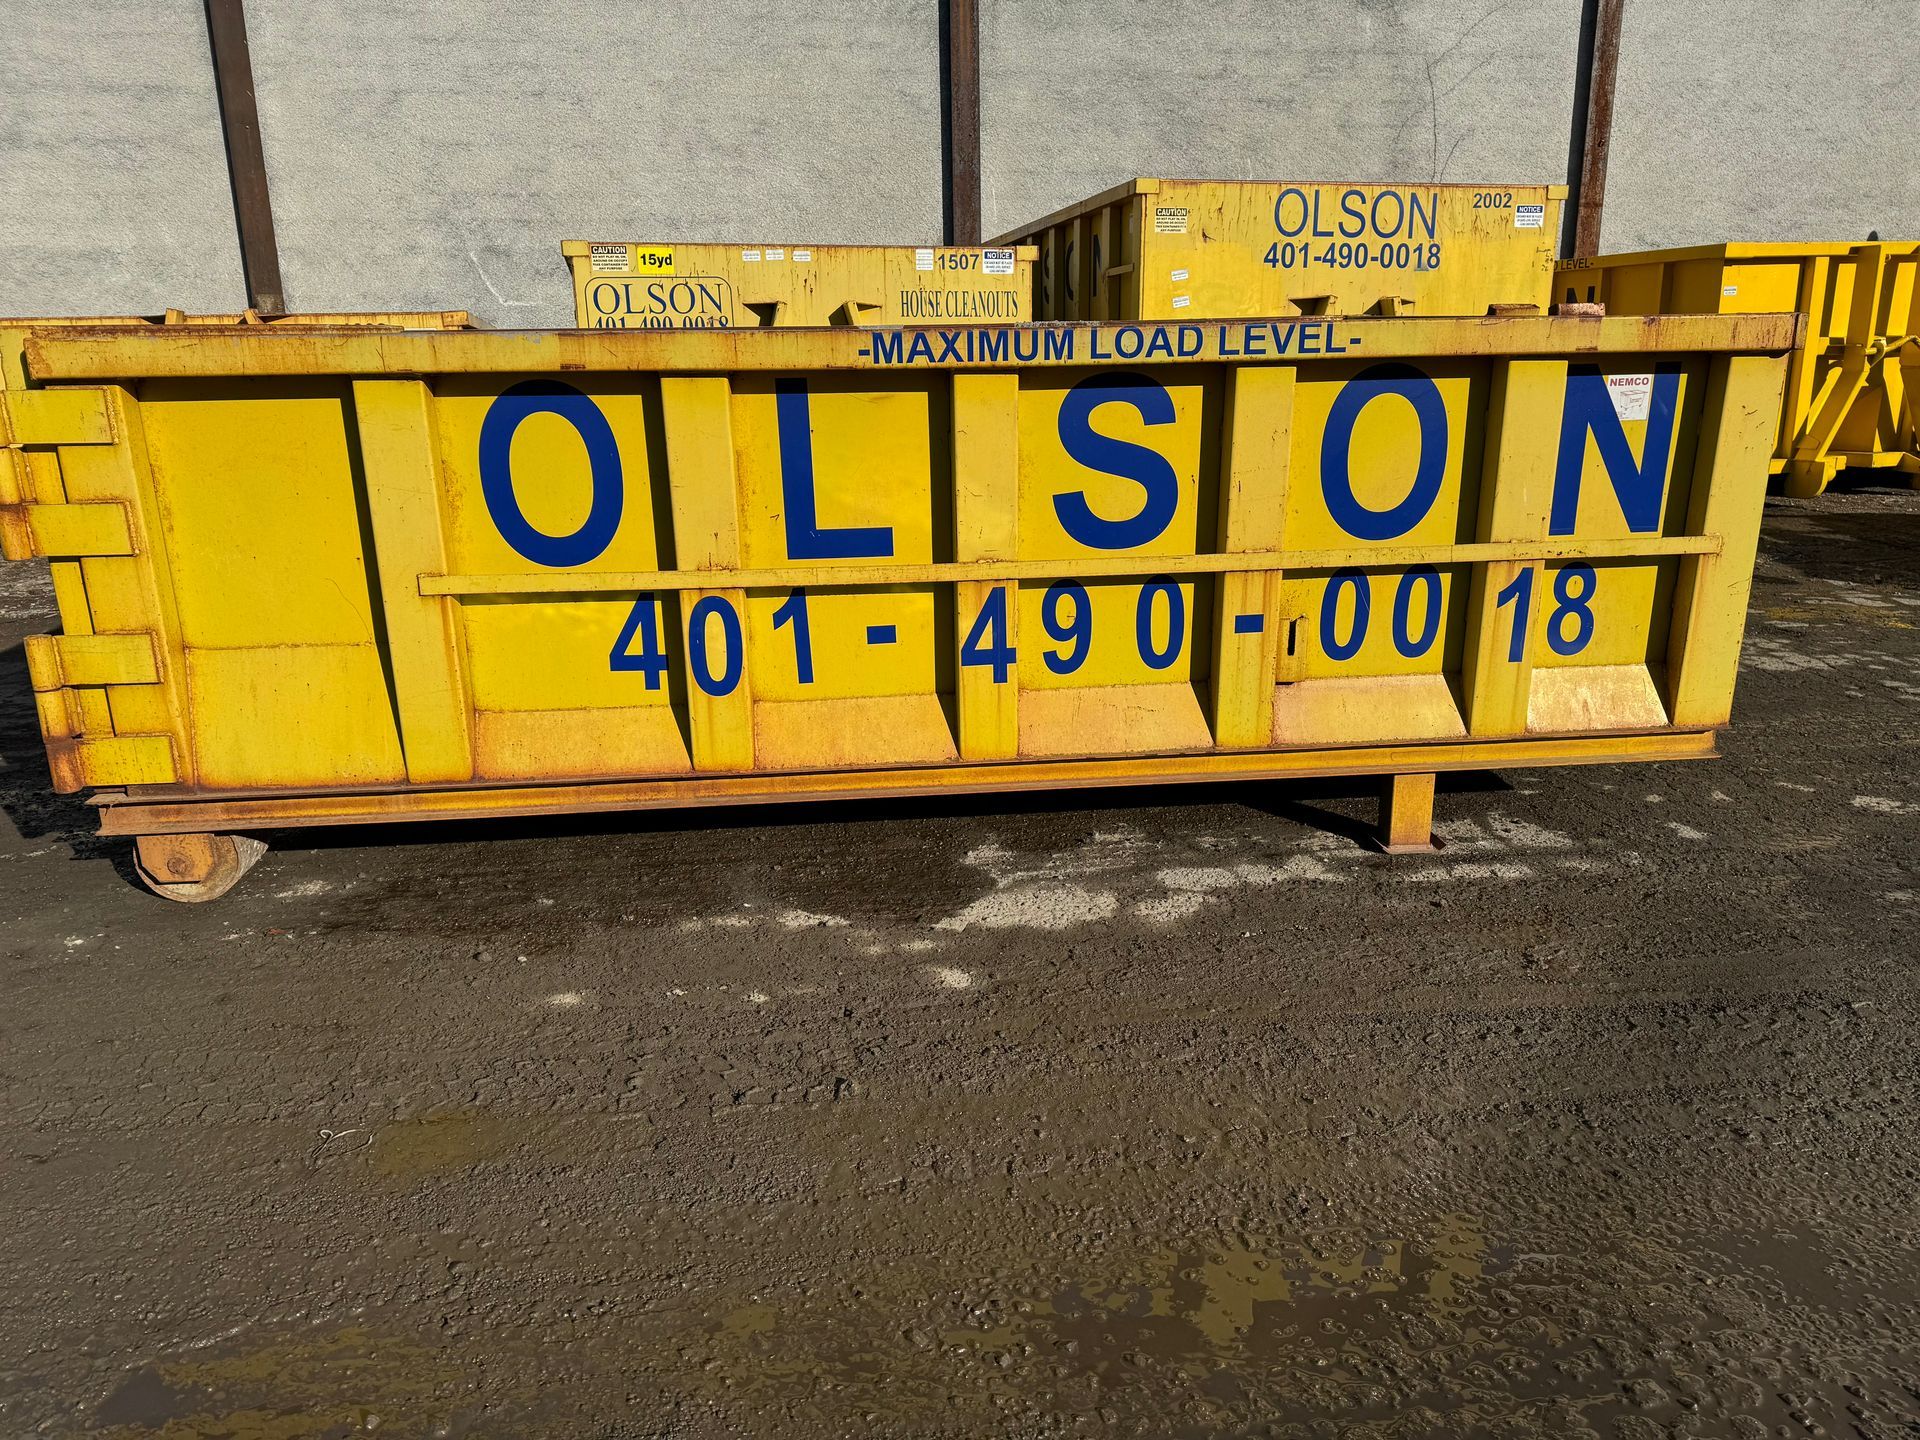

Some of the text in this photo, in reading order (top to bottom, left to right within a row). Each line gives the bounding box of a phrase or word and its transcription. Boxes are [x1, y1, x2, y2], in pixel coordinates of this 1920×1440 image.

[1473, 193, 1512, 209] 2002
[1156, 208, 1187, 216] CAUTION
[1274, 188, 1437, 240] OLSON
[592, 246, 626, 254] CAUTION
[1264, 242, 1441, 269] 401-490-0018
[640, 254, 673, 268] 15yd
[938, 253, 980, 270] 1507
[593, 283, 724, 315] OLSON
[900, 290, 1019, 317] HOUSE CLEANOUTS
[594, 315, 729, 328] 4014900018
[858, 322, 1362, 364] -MAXIMUM LOAD LEVEL-
[1609, 377, 1650, 387] NEMCO
[479, 362, 1681, 568] OLSON
